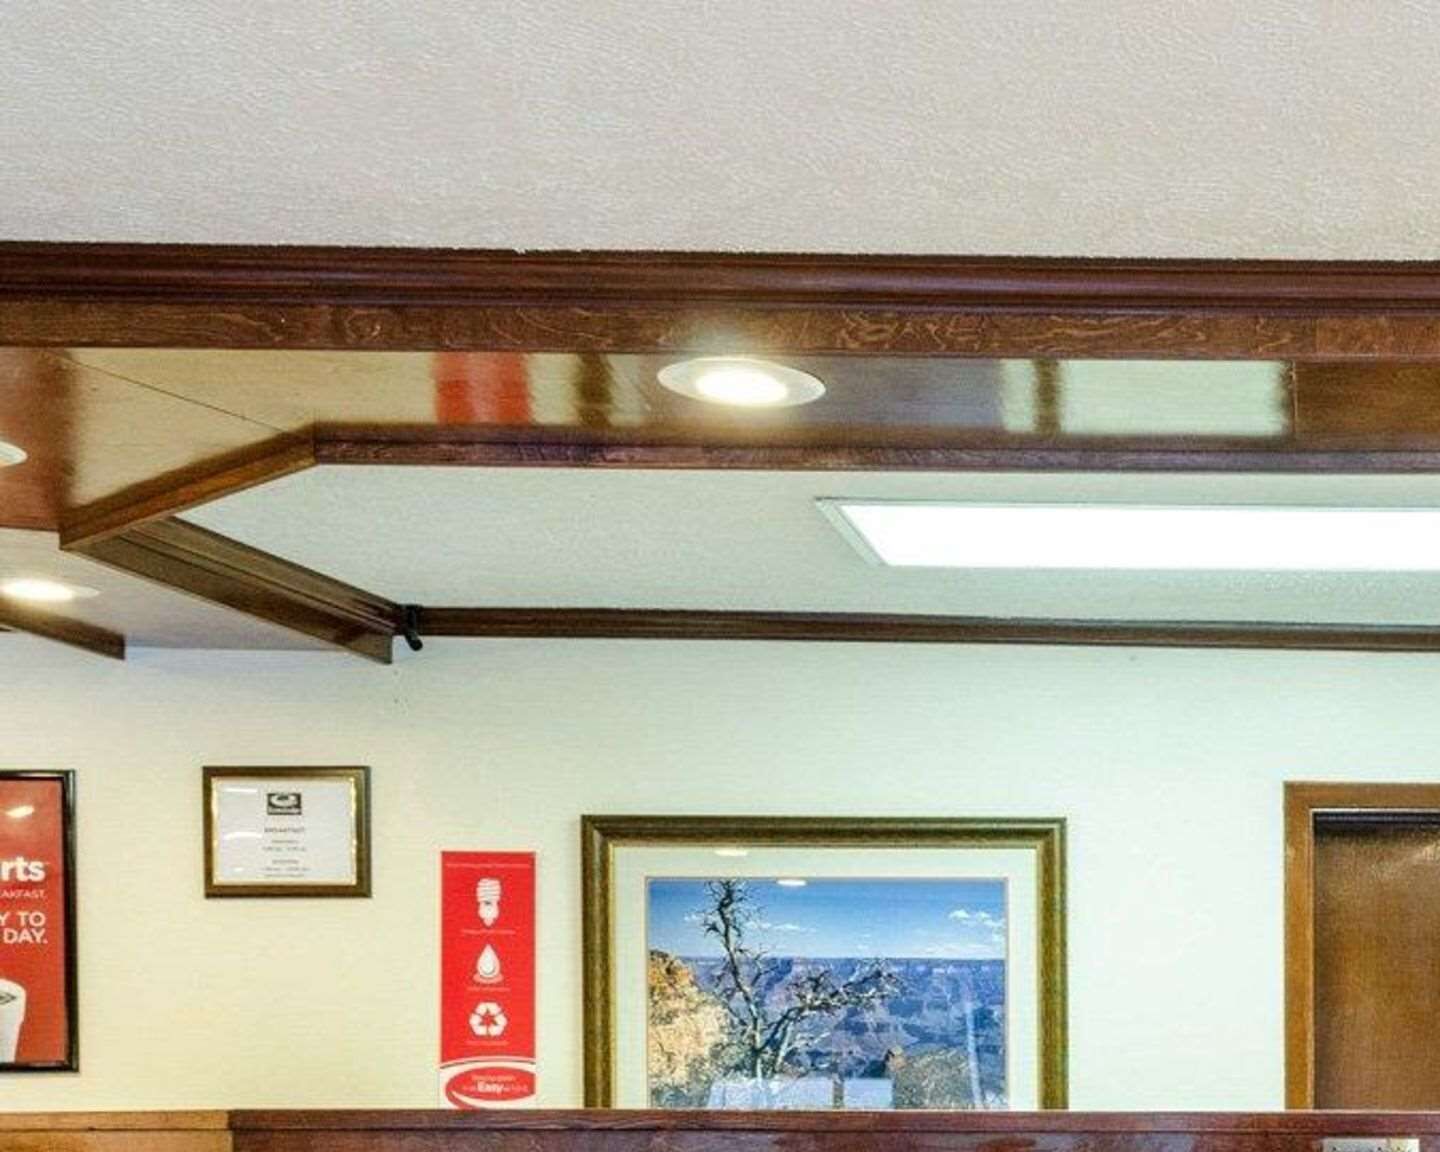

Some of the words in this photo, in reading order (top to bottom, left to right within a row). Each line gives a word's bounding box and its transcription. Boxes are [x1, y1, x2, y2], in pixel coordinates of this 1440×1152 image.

[0, 856, 46, 882] rts
[17, 911, 46, 927] TO
[3, 928, 48, 944] DAY.
[476, 1081, 504, 1096] Easy
